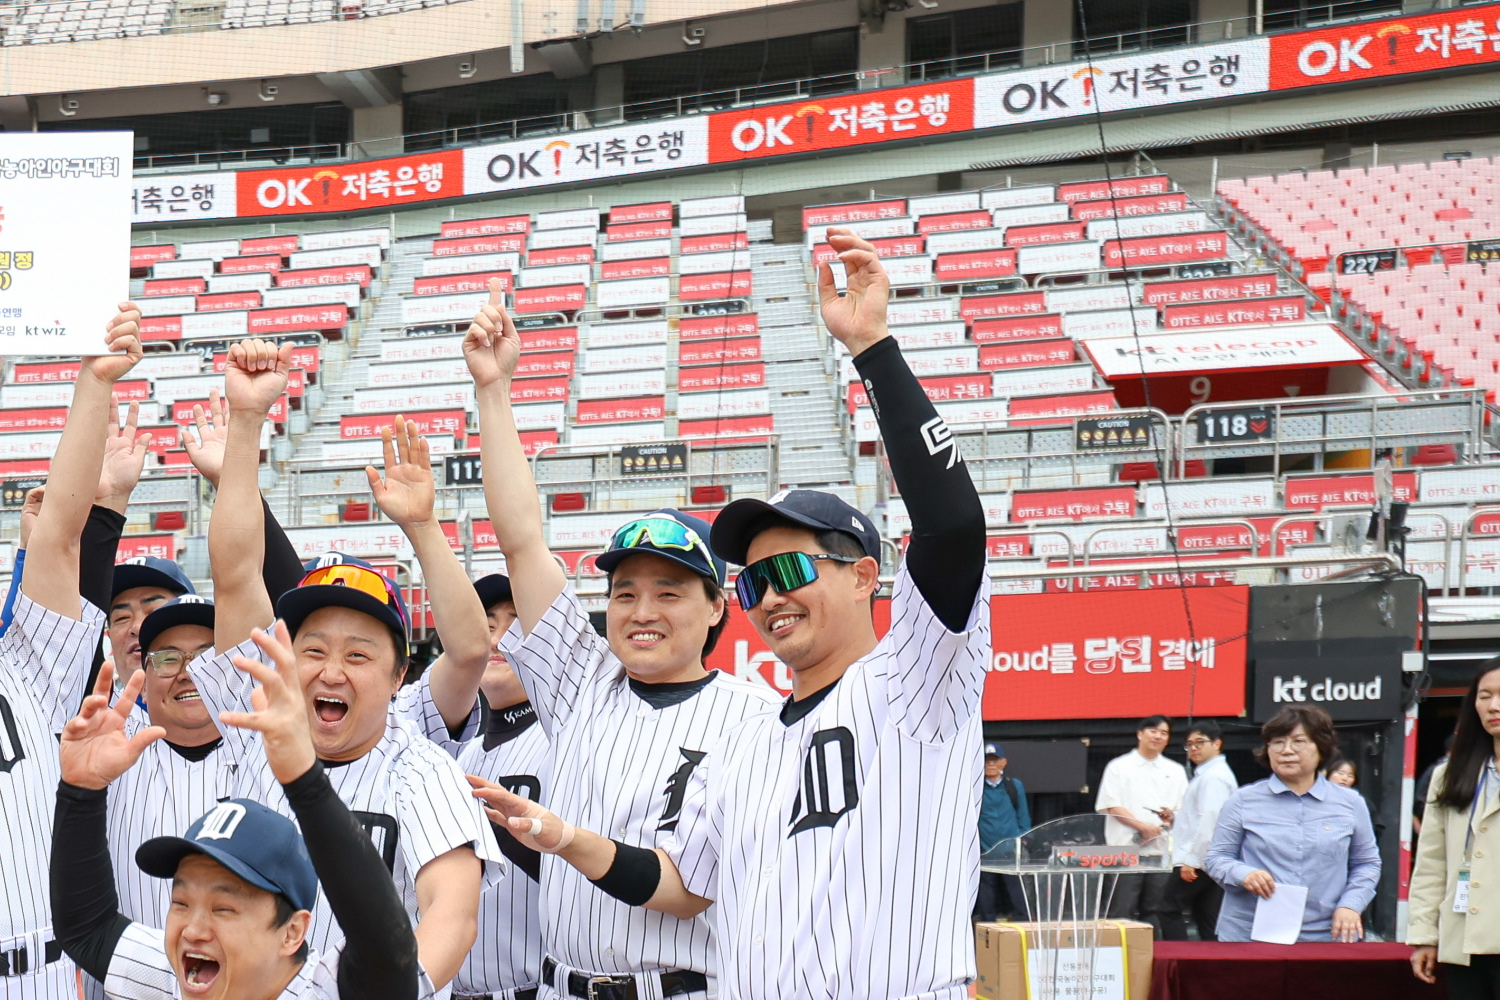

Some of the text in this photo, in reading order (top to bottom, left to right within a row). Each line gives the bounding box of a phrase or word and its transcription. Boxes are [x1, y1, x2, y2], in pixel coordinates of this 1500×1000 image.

[1108, 52, 1241, 98] 저축은행
[828, 93, 950, 138] 저축은행
[574, 129, 685, 168] 저축은행
[341, 163, 443, 199] 저축은행
[1139, 247, 1157, 256] AI도
[1159, 243, 1192, 255] KT에서
[1195, 240, 1222, 252] 구독!
[14, 251, 33, 269] 정
[1344, 257, 1379, 274] 227
[1149, 284, 1272, 304] OTT도 AI도 KT에서 구독!
[1170, 305, 1299, 327] OTT도 AI도 KT에서 구독!
[25, 325, 38, 336] kt
[42, 321, 66, 336] wiz
[1176, 338, 1318, 353] telecop
[1189, 377, 1212, 404] 9
[641, 407, 661, 418] 구독!
[1097, 420, 1130, 428] CAUTION
[1205, 415, 1248, 438] 118
[638, 447, 667, 455] CAUTION
[1290, 494, 1319, 505] OTT도
[1322, 493, 1340, 503] AI도
[1017, 501, 1130, 519] OTT도 AI도 KT에서 구독!
[1184, 537, 1213, 547] OTT도
[1216, 536, 1236, 546] AI도
[1158, 637, 1216, 671] 곁에
[1273, 676, 1382, 703] kt cloud
[515, 707, 536, 718] KAM
[1053, 849, 1139, 869] kt sports
